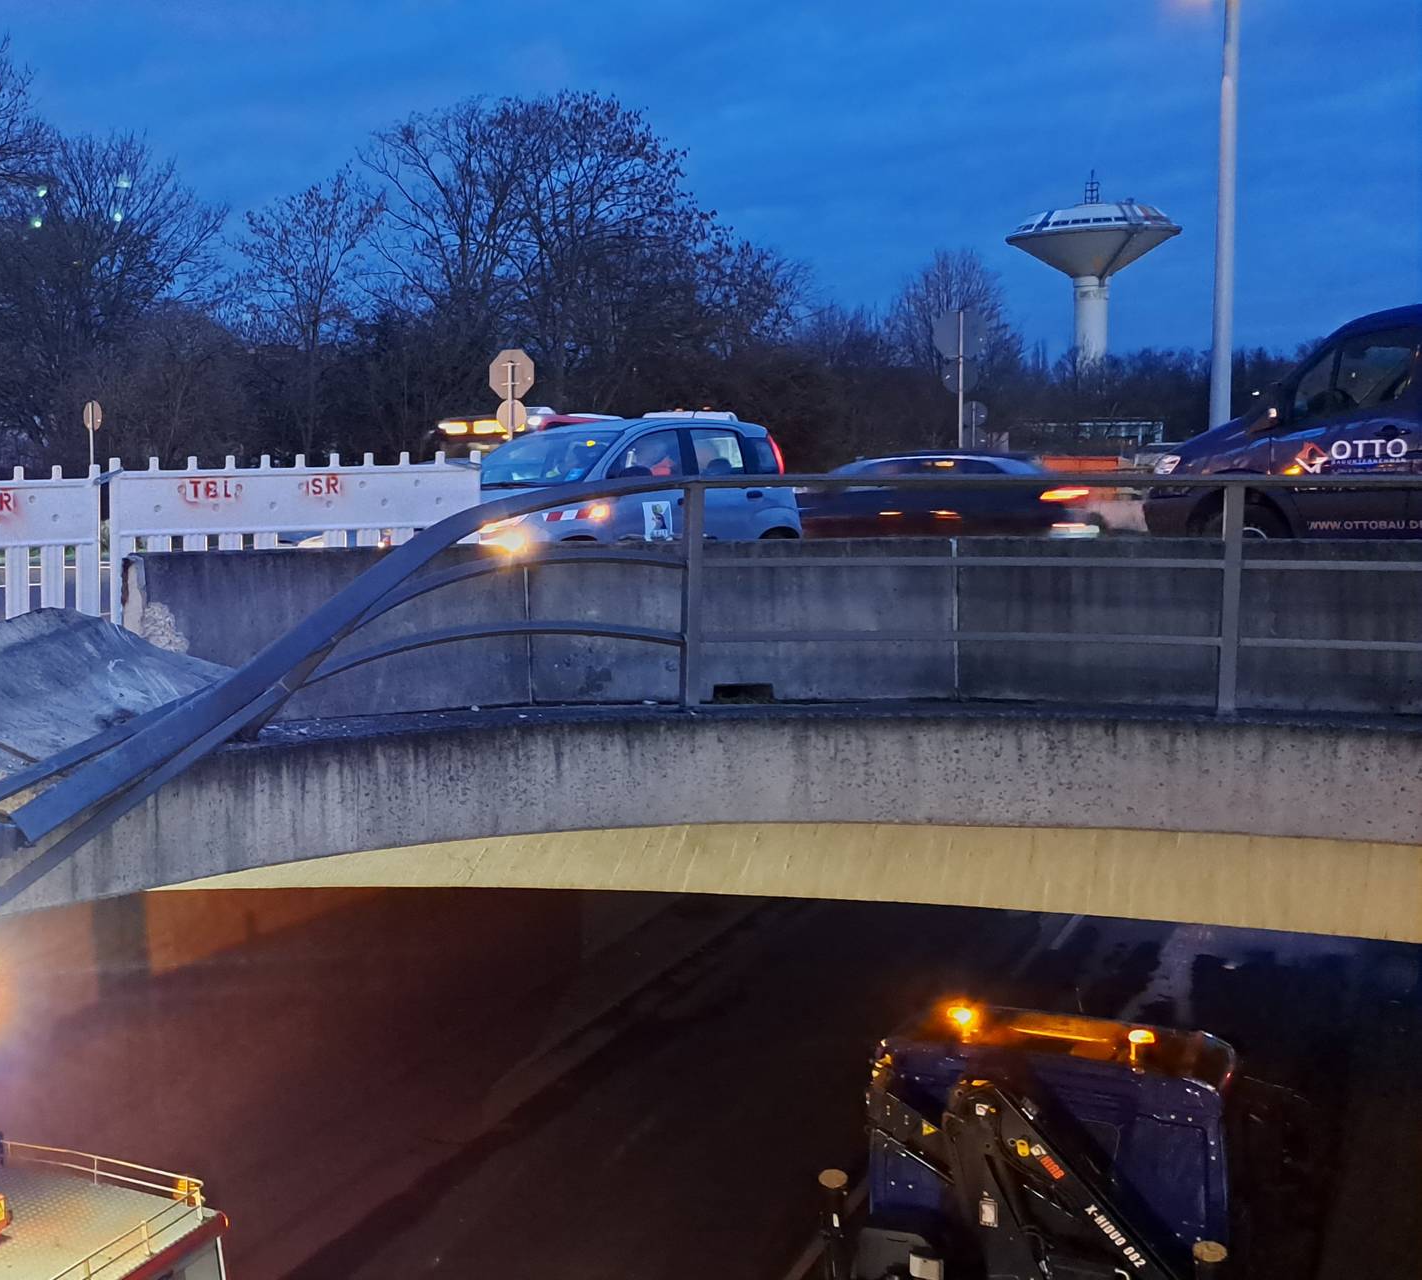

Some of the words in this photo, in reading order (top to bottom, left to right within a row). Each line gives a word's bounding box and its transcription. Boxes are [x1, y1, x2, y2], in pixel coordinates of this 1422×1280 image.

[1331, 438, 1408, 460] OTTO
[189, 480, 232, 499] TBL
[311, 476, 339, 496] SR
[1040, 1154, 1065, 1180] HIAB
[1084, 1204, 1127, 1246] X-HIDUO
